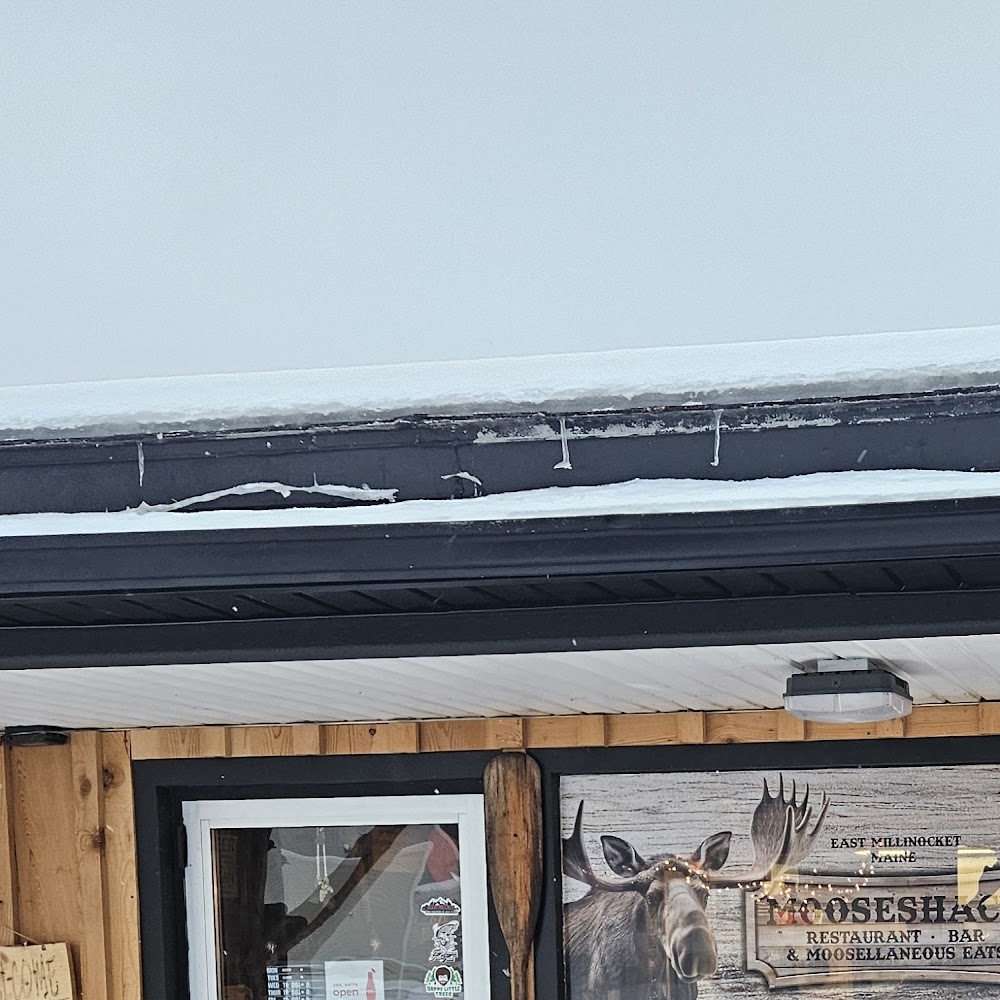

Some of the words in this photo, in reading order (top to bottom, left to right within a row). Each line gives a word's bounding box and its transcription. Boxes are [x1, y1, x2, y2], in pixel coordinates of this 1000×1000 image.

[831, 838, 865, 849] EAST
[871, 835, 962, 848] MILLINOCKET
[871, 851, 916, 863] MAINE
[806, 930, 922, 945] RESTAURANT
[948, 929, 985, 943] BAR
[786, 949, 799, 962] &
[806, 946, 955, 962] MOOSELLANEOUS
[333, 989, 359, 998] open
